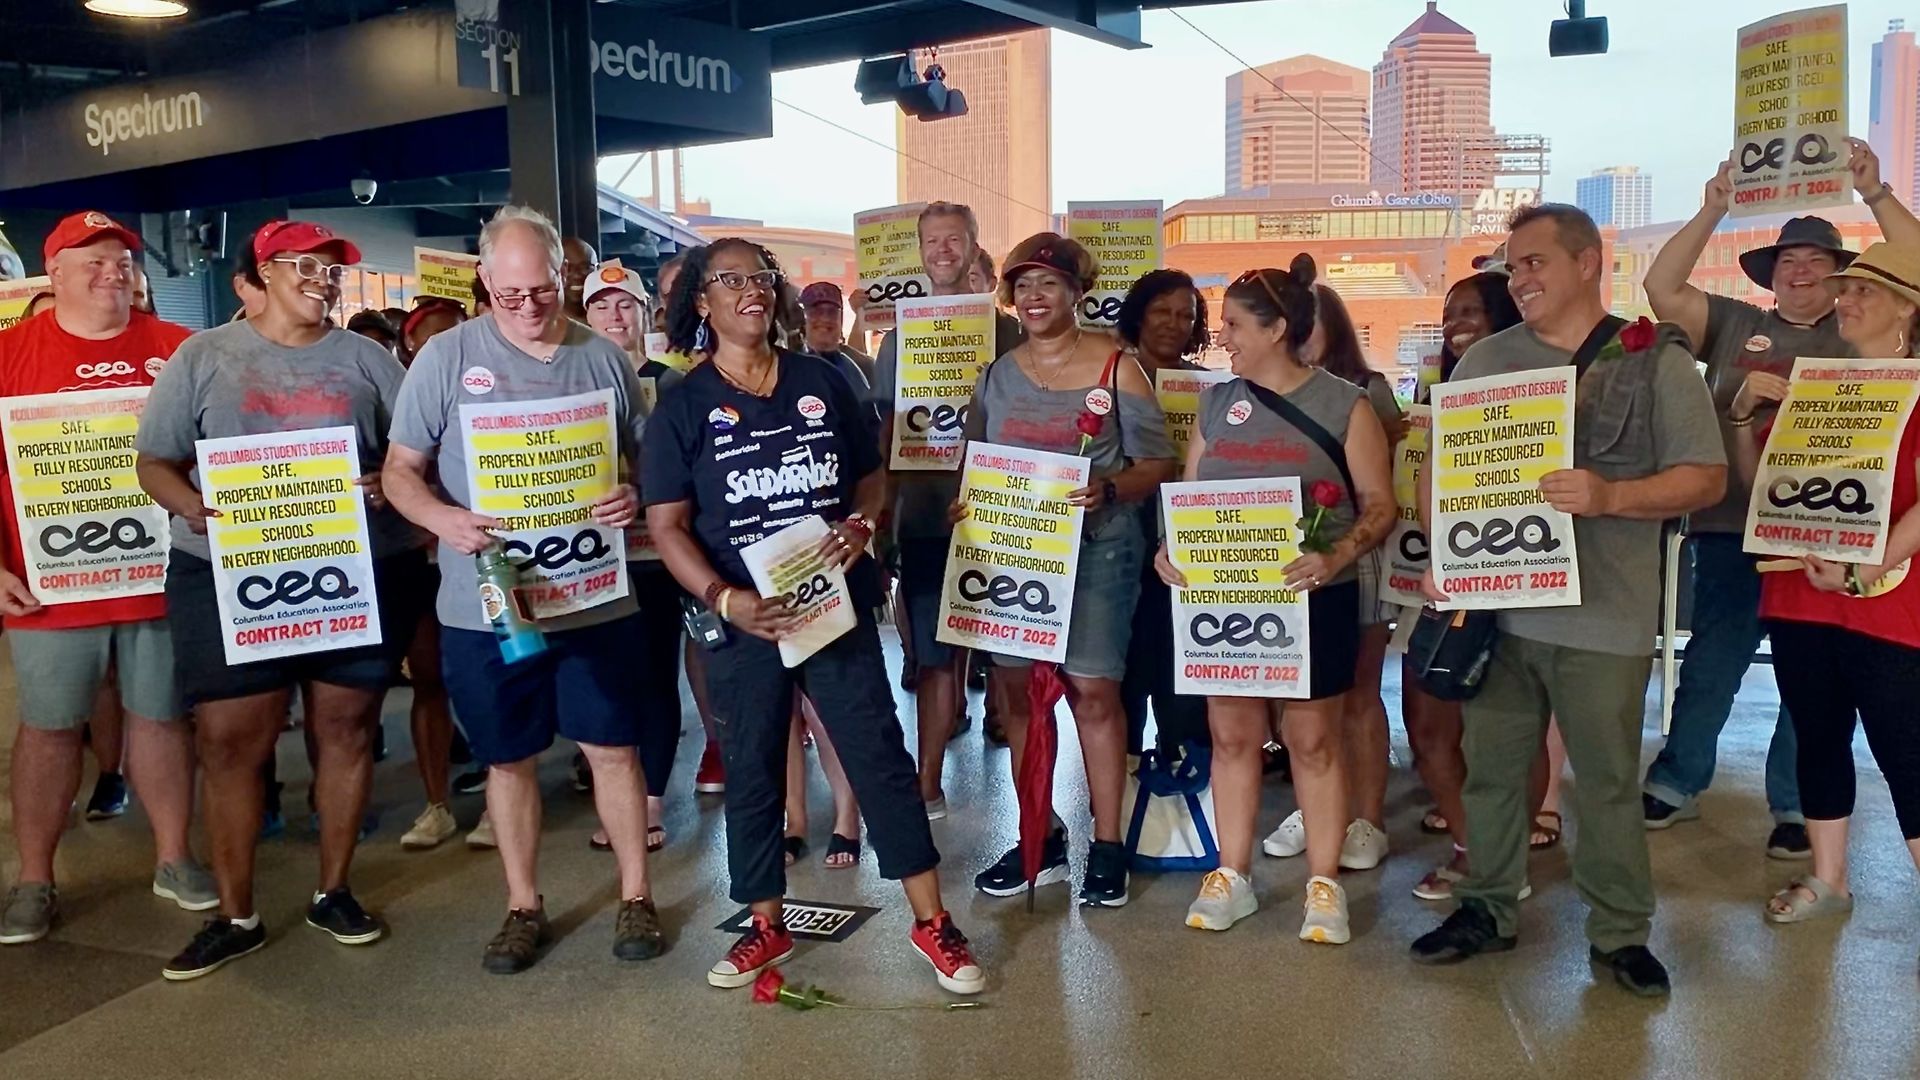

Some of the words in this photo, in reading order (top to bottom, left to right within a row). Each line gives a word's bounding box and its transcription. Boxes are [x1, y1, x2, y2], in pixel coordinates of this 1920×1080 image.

[456, 20, 520, 49] SECTION
[481, 44, 520, 96] 11
[85, 90, 202, 156] Spectrum
[1331, 193, 1383, 207] Columbia
[1385, 193, 1410, 206] Gas
[1411, 195, 1421, 205] of
[1423, 192, 1451, 204] Ohio
[1473, 188, 1534, 210] AEP
[1102, 222, 1121, 232] SAFE,
[1477, 214, 1505, 223] POW
[1108, 236, 1153, 246] MAINTAINED,
[1103, 250, 1145, 260] RESOURCED
[865, 280, 927, 302] cea
[1084, 296, 1121, 320] ce
[934, 320, 953, 331] SAFE,
[905, 337, 939, 349] PROPERLY
[941, 335, 984, 348] MAINTAINED,
[913, 352, 934, 364] FULLY
[936, 351, 976, 363] RESOURCED
[76, 361, 136, 378] cea
[146, 363, 162, 371] ce
[929, 369, 962, 381] SCHOOLS
[465, 378, 491, 387] cea
[1836, 384, 1863, 396] SAFE,
[902, 388, 909, 398] IN
[910, 387, 933, 398] EVERY
[1441, 391, 1487, 410] #COLUMBUS
[1488, 386, 1526, 404] STUDENTS
[1528, 380, 1567, 397] DESERVE
[801, 404, 824, 413] cea
[1088, 398, 1108, 409] cea
[1790, 401, 1837, 413] PROPERLY
[1839, 401, 1898, 413] MAINTAINED,
[472, 410, 526, 430] #COLUMBUS
[528, 407, 572, 427] STUDENTS
[1165, 412, 1196, 425] PROPER
[1484, 405, 1513, 422] SAFE,
[1793, 416, 1821, 429] FULLY
[1823, 417, 1882, 430] RESOURCED
[526, 430, 561, 446] SAFE,
[1444, 430, 1491, 448] PROPERLY
[1491, 421, 1558, 441] MAINTAINED,
[1807, 436, 1852, 448] SCHOOLS
[18, 440, 72, 458] PROPERLY
[74, 435, 136, 452] MAINTAINE
[208, 448, 261, 466] #COLUMBUS
[263, 444, 308, 460] STUDENTS
[309, 440, 348, 456] DESERVE
[898, 446, 958, 457] CONTRACT
[1454, 449, 1482, 468] FULLY
[1484, 443, 1544, 464] RESOURCED
[479, 451, 535, 470] PROPERLY
[539, 442, 606, 465] MAINTAINED,
[973, 455, 1011, 470] #COLUMBUS
[1767, 452, 1778, 466] IN
[1780, 453, 1809, 467] EVERY
[33, 460, 65, 476] FULLY
[69, 455, 133, 472] RESOURCED
[262, 463, 296, 479] SAFE,
[495, 471, 528, 489] FULLY
[531, 464, 596, 486] RESOURCED
[1006, 476, 1032, 492] SAFE,
[1475, 469, 1519, 487] SCHOOLS
[62, 478, 112, 494] SCHOOLS
[216, 488, 272, 505] PROPERLY
[275, 479, 347, 499] MAINTAINED,
[1768, 475, 1874, 515] cea
[24, 505, 35, 518] IN
[38, 500, 70, 517] EVERY
[72, 492, 155, 513] NEIGHBORHOOD.
[523, 489, 574, 508] SCHOOLS
[968, 489, 1008, 508] PROPERLY
[1171, 492, 1216, 508] #COLUMBUS
[1216, 491, 1256, 505] STUDENTS
[1258, 490, 1293, 503] DESERVE
[1440, 498, 1449, 513] IN
[1450, 495, 1479, 512] EVERY
[233, 507, 266, 523] FULLY
[269, 500, 336, 520] RESOURCED
[974, 508, 999, 524] FULLY
[1001, 513, 1056, 533] RESOURCED
[1216, 509, 1245, 525] SAFE,
[1757, 510, 1792, 520] Columbus
[1795, 513, 1832, 523] Education
[1835, 515, 1881, 527] Association
[40, 518, 155, 557] cea
[262, 524, 313, 542] SCHOOLS
[990, 532, 1032, 550] SCHOOLS
[1177, 529, 1224, 543] PROPERLY
[1226, 528, 1289, 543] MAINTAINED,
[1448, 515, 1561, 558] cea
[1754, 524, 1833, 541] CONTRACT
[1839, 532, 1876, 548] 2022
[37, 561, 76, 570] Columbus
[78, 556, 118, 567] Education
[120, 551, 166, 562] Association
[221, 556, 234, 570] IN
[237, 551, 270, 568] EVERY
[272, 541, 359, 563] NEIGHBORHOOD.
[955, 545, 964, 559] IN
[965, 547, 992, 564] EVERY
[993, 552, 1066, 575] NEIGHBORHOOD.
[1190, 549, 1218, 563] FULLY
[1220, 548, 1279, 562] RESOURCED
[1442, 562, 1478, 571] Columbus
[1481, 559, 1520, 568] Education
[1524, 556, 1570, 566] Association
[579, 558, 619, 575] Association
[40, 569, 121, 589] CONTRACT
[128, 564, 164, 580] 2022
[585, 571, 616, 593] 2022
[1213, 569, 1258, 584] SCHOOLS
[1443, 574, 1524, 593] CONTRACT
[1530, 572, 1567, 588] 2022
[237, 567, 358, 610] cea
[958, 570, 1056, 614] cea
[1180, 591, 1190, 604] IN
[1191, 590, 1221, 604] EVERY
[1222, 589, 1297, 604] NEIGHBORHOOD.
[233, 614, 274, 625] Columbus
[277, 608, 319, 620] Education
[322, 601, 369, 613] Association
[823, 597, 841, 612] 2022
[950, 601, 982, 615] Columbus
[984, 608, 1018, 621] Education
[1020, 614, 1062, 628] Association
[235, 621, 323, 646] CONTRACT
[330, 615, 367, 632] 2022
[947, 615, 1019, 639] CONTRACT
[1023, 629, 1056, 646] 2022
[1190, 613, 1294, 648] cea
[1184, 650, 1219, 659] Columbus
[1221, 651, 1256, 659] Education
[1260, 652, 1303, 660] Association
[1184, 664, 1259, 680] CONTRACT
[1265, 666, 1298, 681] 2022
[783, 908, 850, 931] REGI
